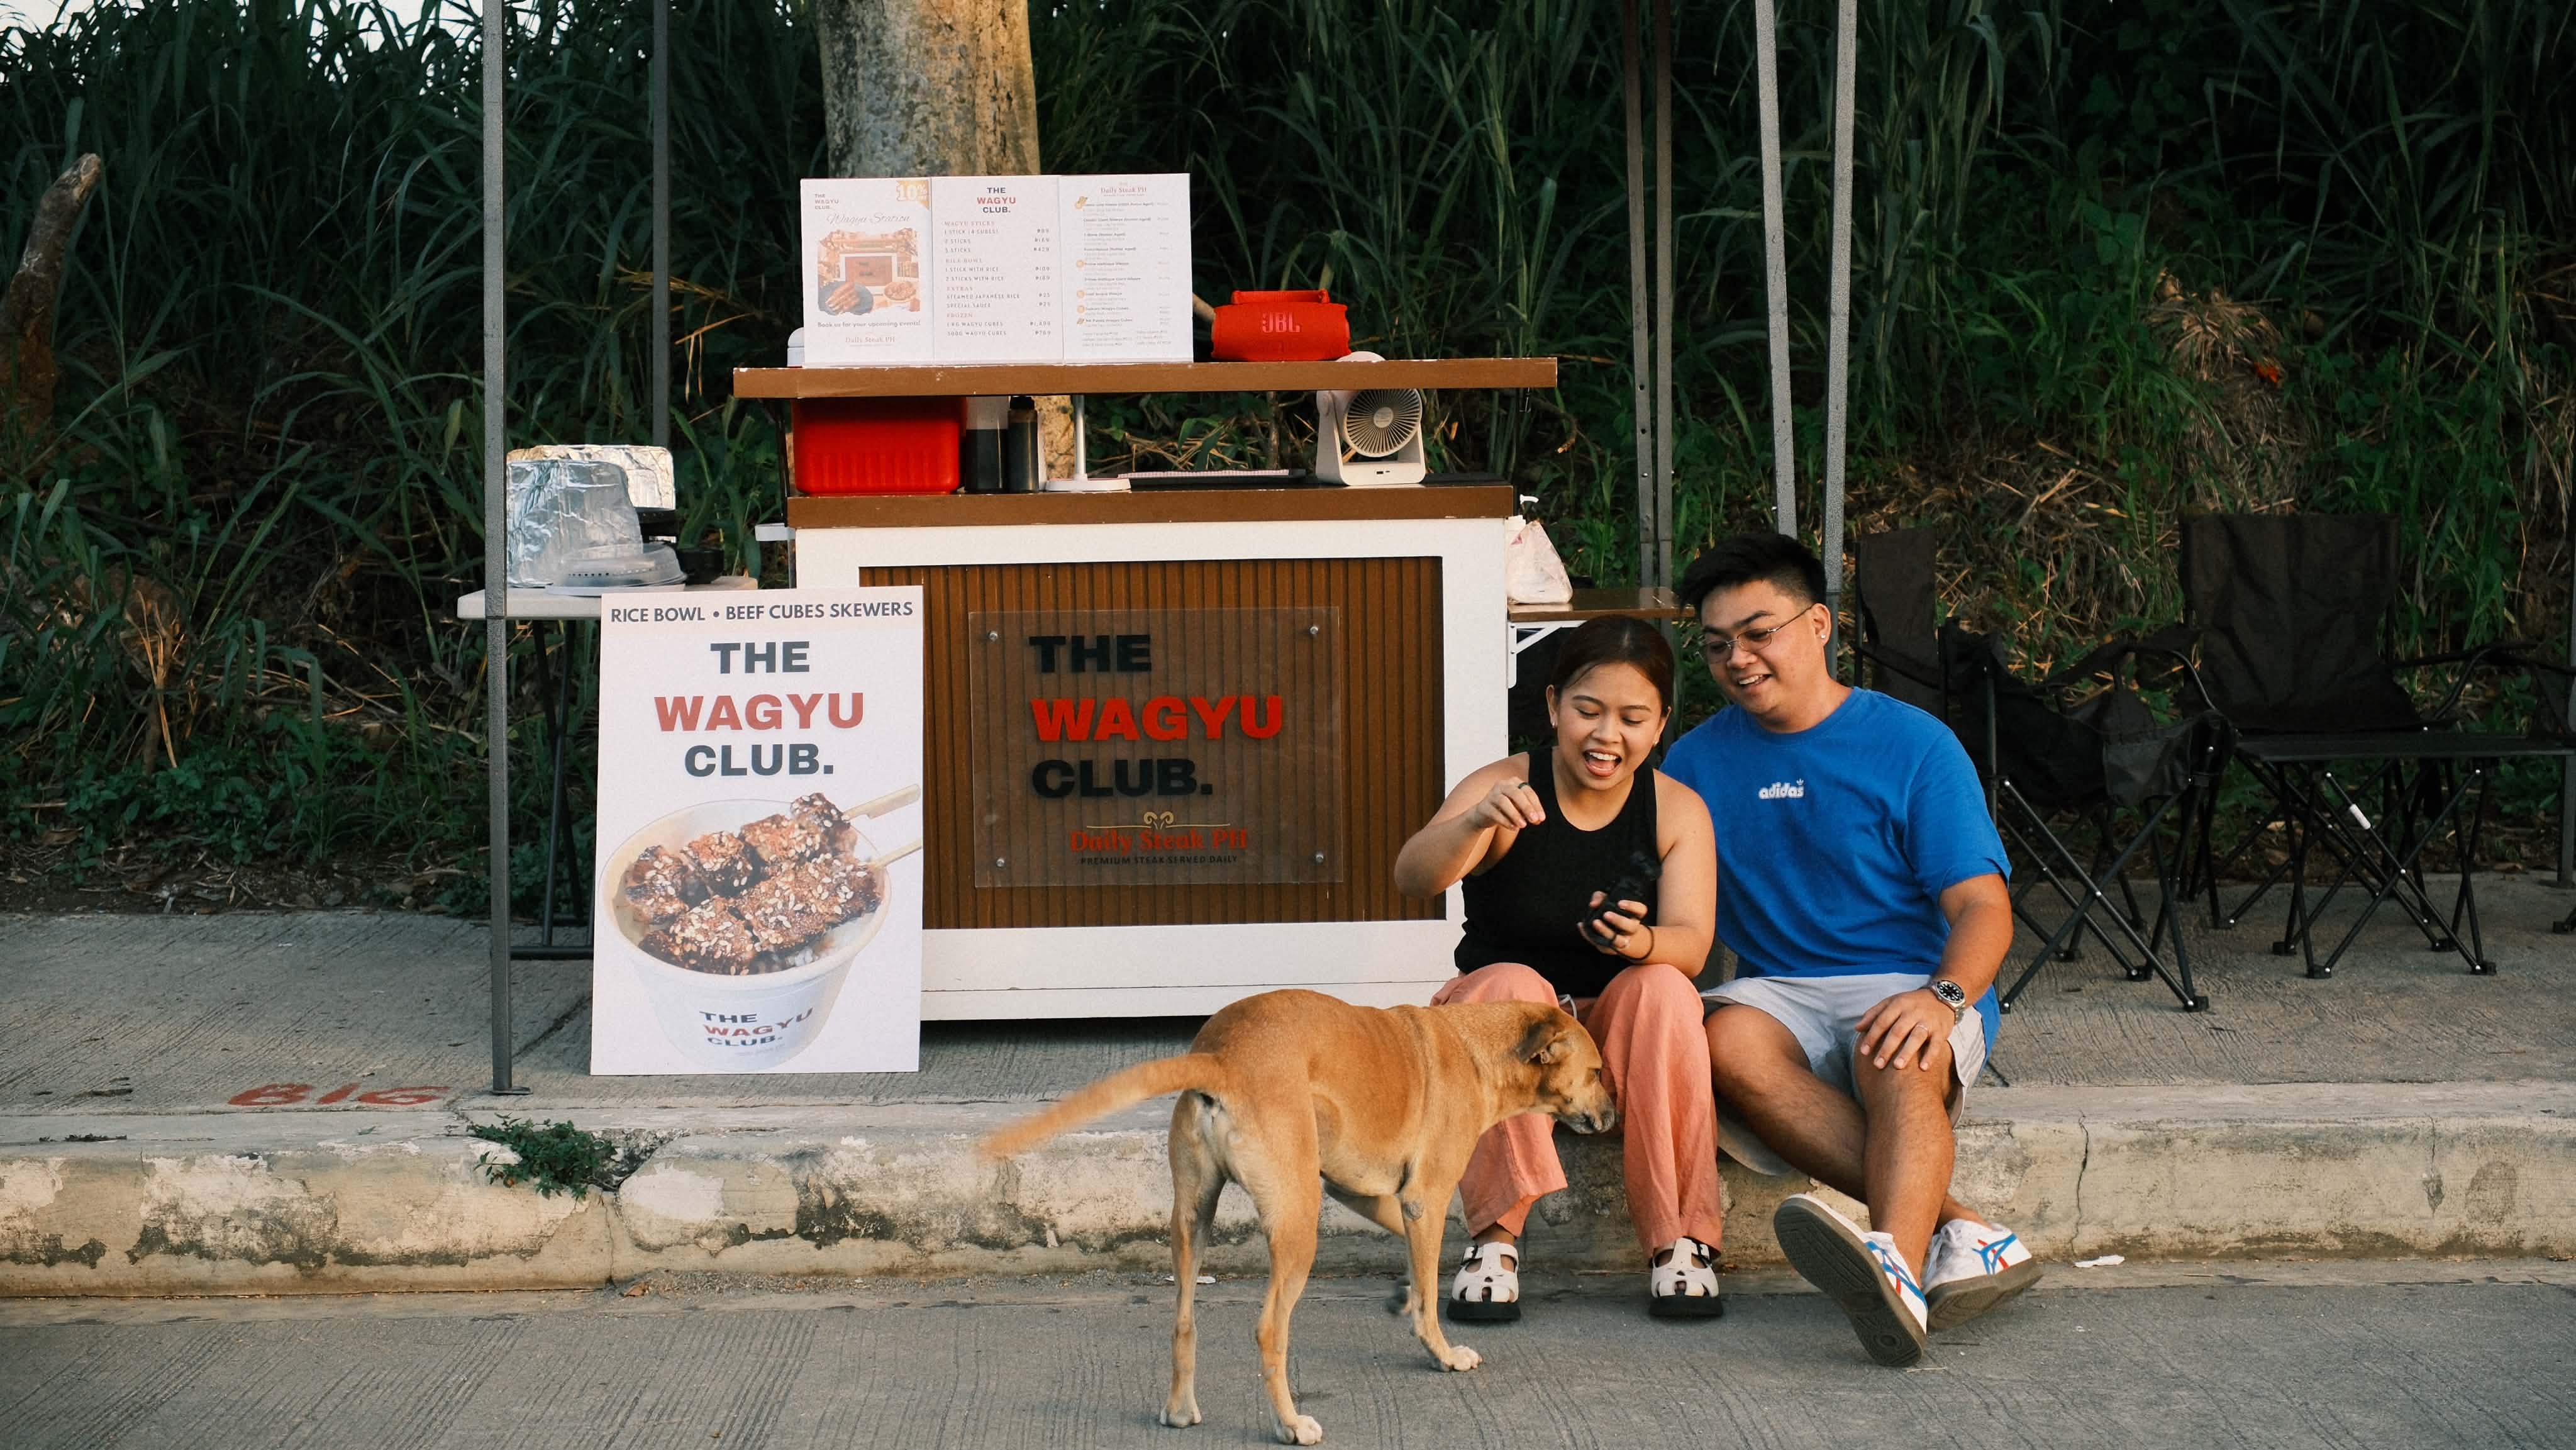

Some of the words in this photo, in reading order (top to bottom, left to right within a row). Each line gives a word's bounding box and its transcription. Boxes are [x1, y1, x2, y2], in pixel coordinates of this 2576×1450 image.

[827, 213, 867, 225] Wagyu
[870, 212, 911, 223] Station
[1262, 311, 1300, 333] JBL
[611, 608, 648, 622] RICE
[654, 607, 705, 622] BOWL
[726, 605, 765, 620] BEEF
[769, 603, 824, 619] CUBES
[830, 601, 913, 618] SKEWERS
[710, 640, 810, 674] THE
[1028, 634, 1152, 673] THE
[654, 693, 863, 732] WAGYU
[1031, 695, 1283, 741] WAGYU
[685, 743, 834, 777] CLUB.
[1031, 758, 1213, 798] CLUB.
[1758, 782, 1804, 799] adidas
[1070, 830, 1131, 855] Daily
[1140, 828, 1206, 850] Steak
[1212, 828, 1248, 849] PH
[1081, 857, 1130, 866] PREMIUM
[1134, 856, 1164, 865] STEAK
[1166, 856, 1207, 864] SERVED
[1209, 855, 1238, 864] DAILY
[699, 1011, 757, 1023] THE
[703, 1007, 813, 1036] WAGYU
[708, 1035, 783, 1046] CLUB.
